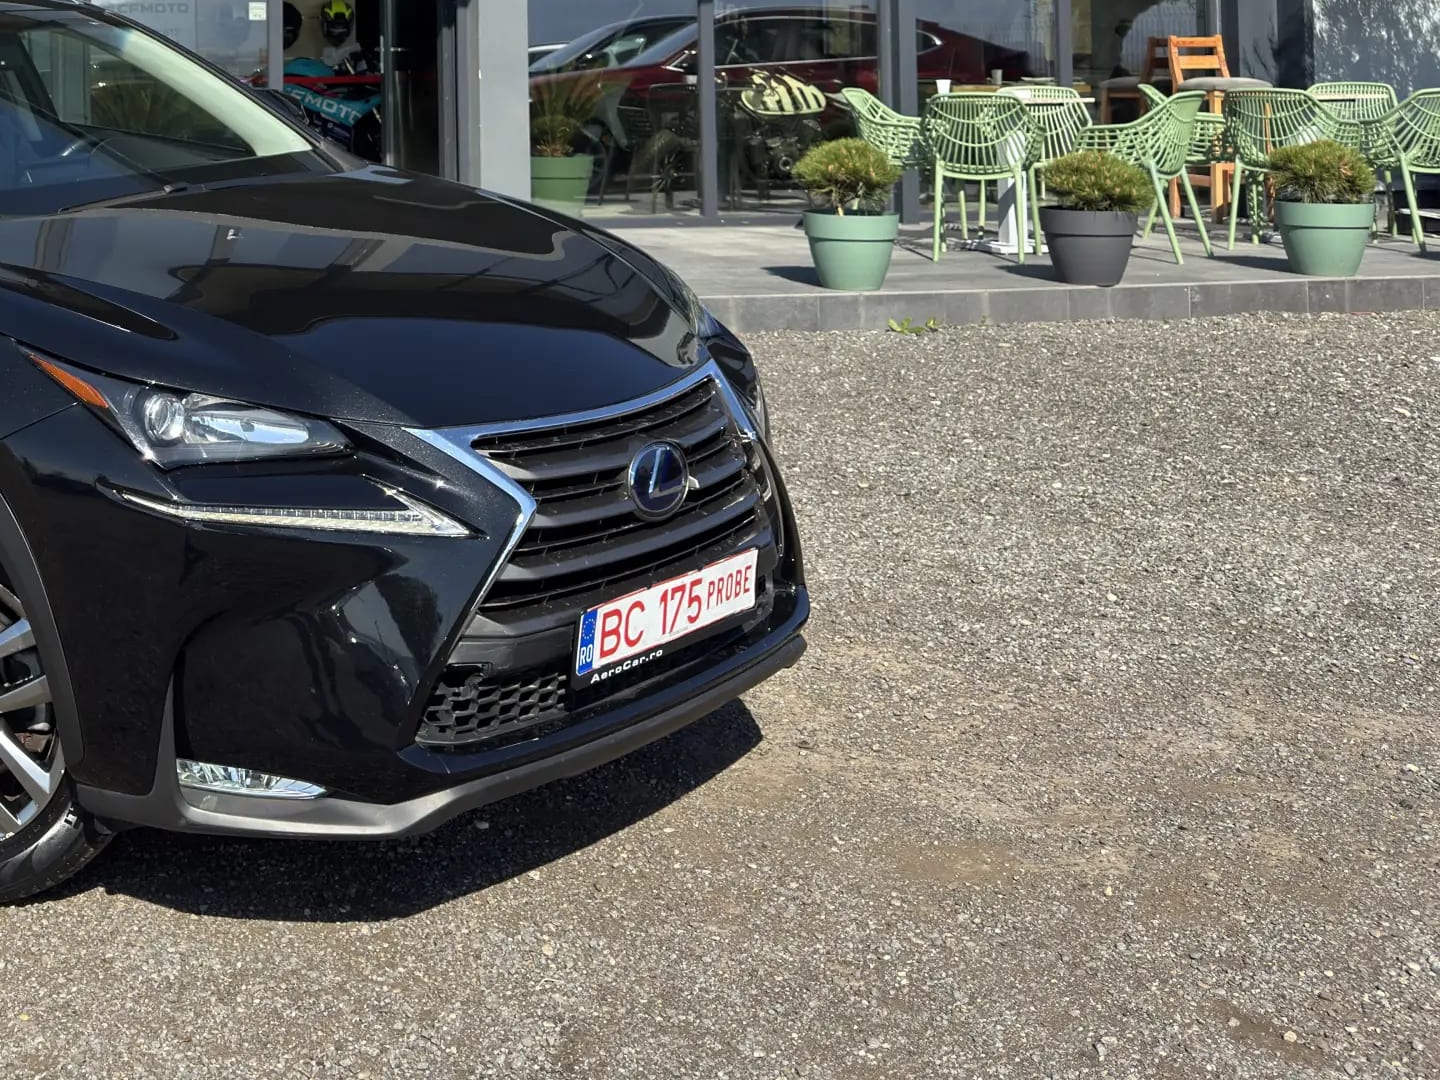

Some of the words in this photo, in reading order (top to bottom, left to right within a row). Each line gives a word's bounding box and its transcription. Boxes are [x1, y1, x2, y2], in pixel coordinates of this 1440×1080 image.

[286, 87, 363, 125] FMOT
[599, 600, 646, 659] BC
[659, 577, 703, 635] 175
[706, 564, 752, 611] PROBE
[579, 643, 594, 667] RO
[590, 648, 664, 684] AeroCar.ro
